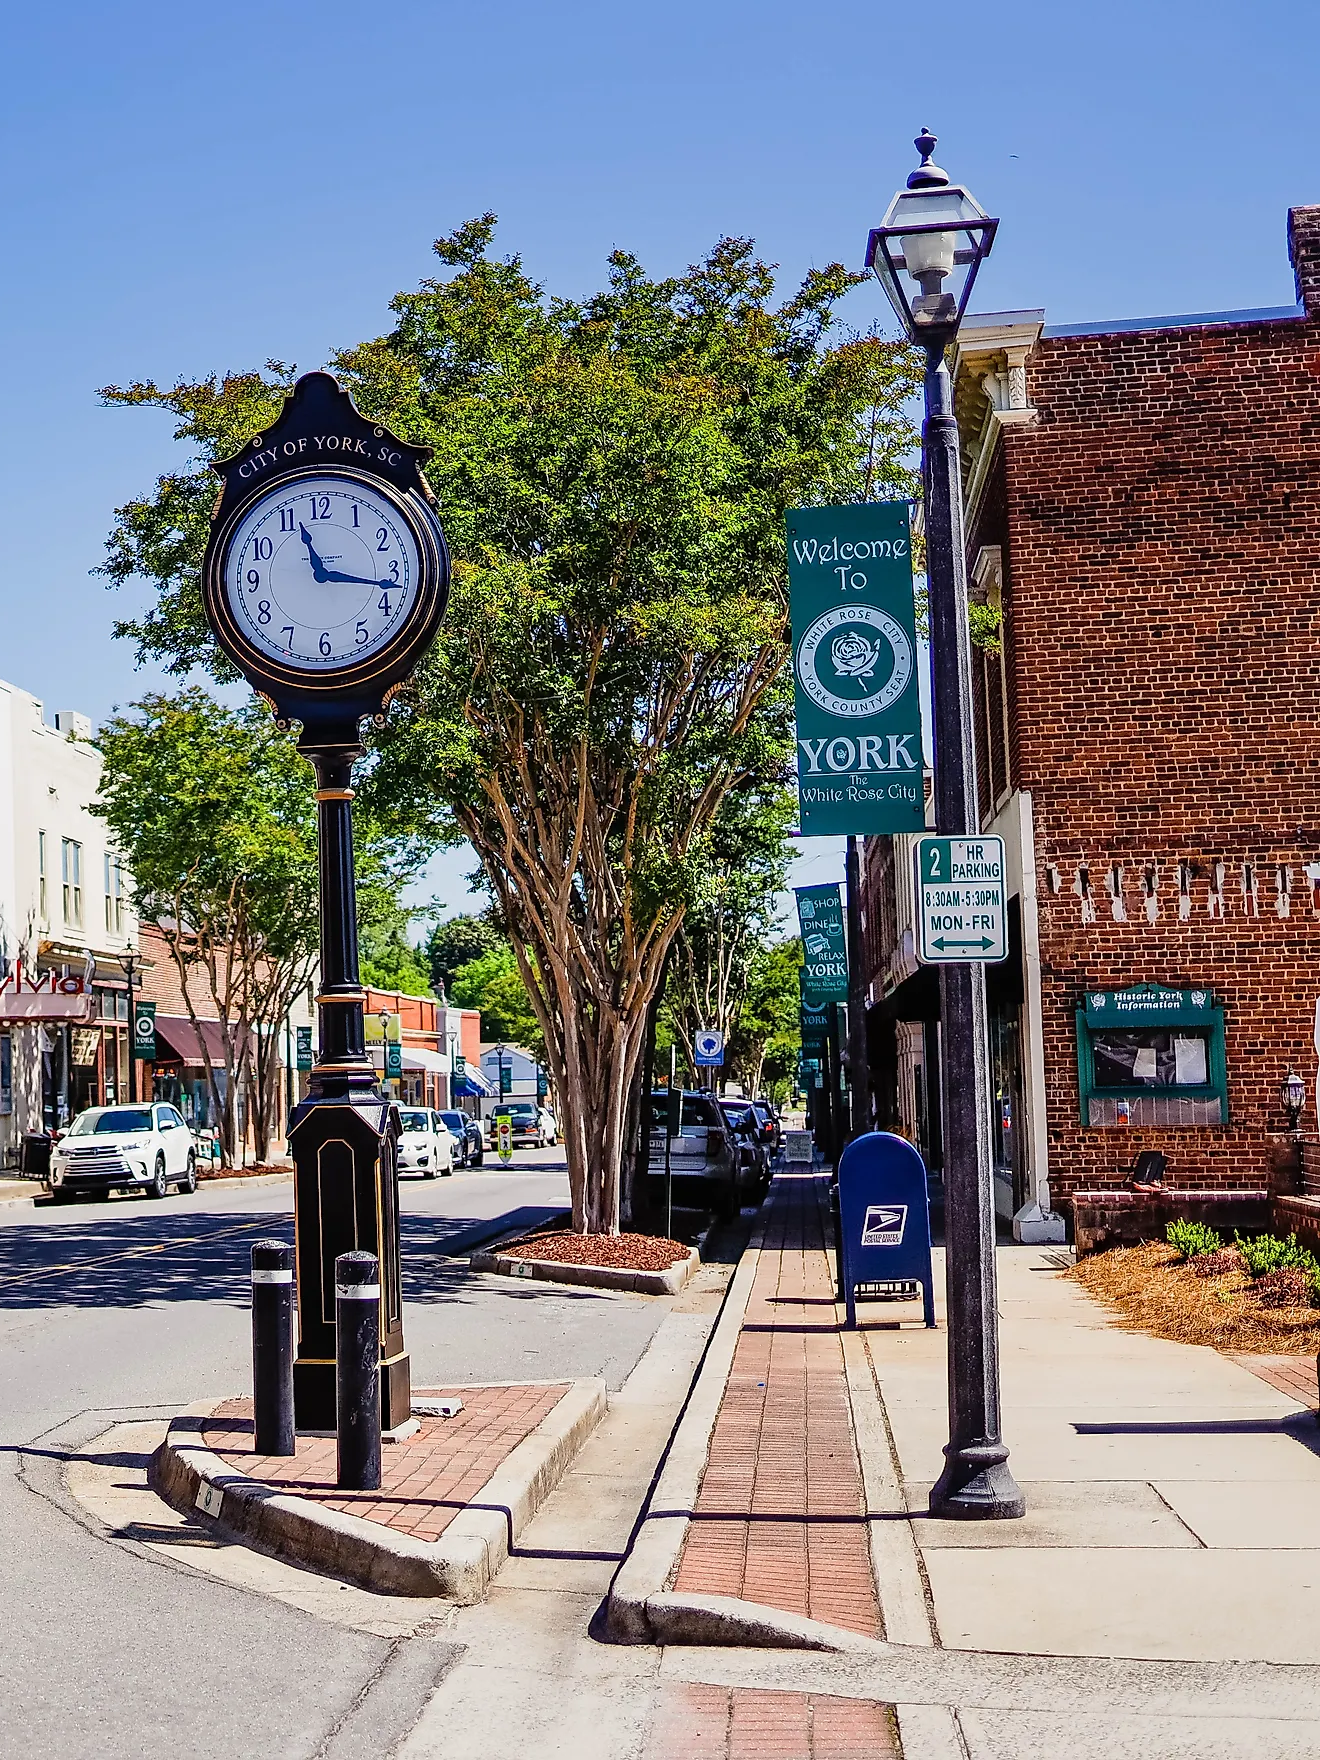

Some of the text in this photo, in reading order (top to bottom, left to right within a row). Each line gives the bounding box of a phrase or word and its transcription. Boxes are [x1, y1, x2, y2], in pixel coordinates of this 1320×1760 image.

[238, 436, 402, 478] CITY OF YORK, SC
[279, 508, 296, 532] 11
[309, 496, 332, 520] 12
[351, 504, 360, 528] 1
[252, 536, 273, 561] 10
[376, 528, 390, 552] 2
[792, 536, 908, 565] Welcome
[247, 570, 260, 593] 9
[388, 560, 400, 583] 3
[834, 564, 868, 591] To
[258, 600, 272, 625] 8
[377, 592, 392, 617] 4
[280, 626, 294, 650] 7
[355, 618, 369, 645] 5
[804, 610, 904, 650] WHITE ROSE CITY
[318, 632, 332, 656] 6
[804, 670, 905, 712] YORK COUNTY SEAT
[798, 733, 919, 773] YORK
[848, 774, 868, 786] The
[802, 784, 916, 802] White Rose City
[930, 848, 941, 876] 2
[966, 845, 984, 860] HR
[952, 862, 1000, 878] PARKING
[814, 897, 840, 909] SHOP
[804, 920, 829, 931] DINE
[818, 951, 846, 962] RELAX
[806, 962, 847, 977] YORK
[1114, 991, 1184, 1001] Historic York
[1116, 1000, 1180, 1011] Information
[802, 1015, 828, 1024] YORK
[136, 1036, 155, 1044] YORK
